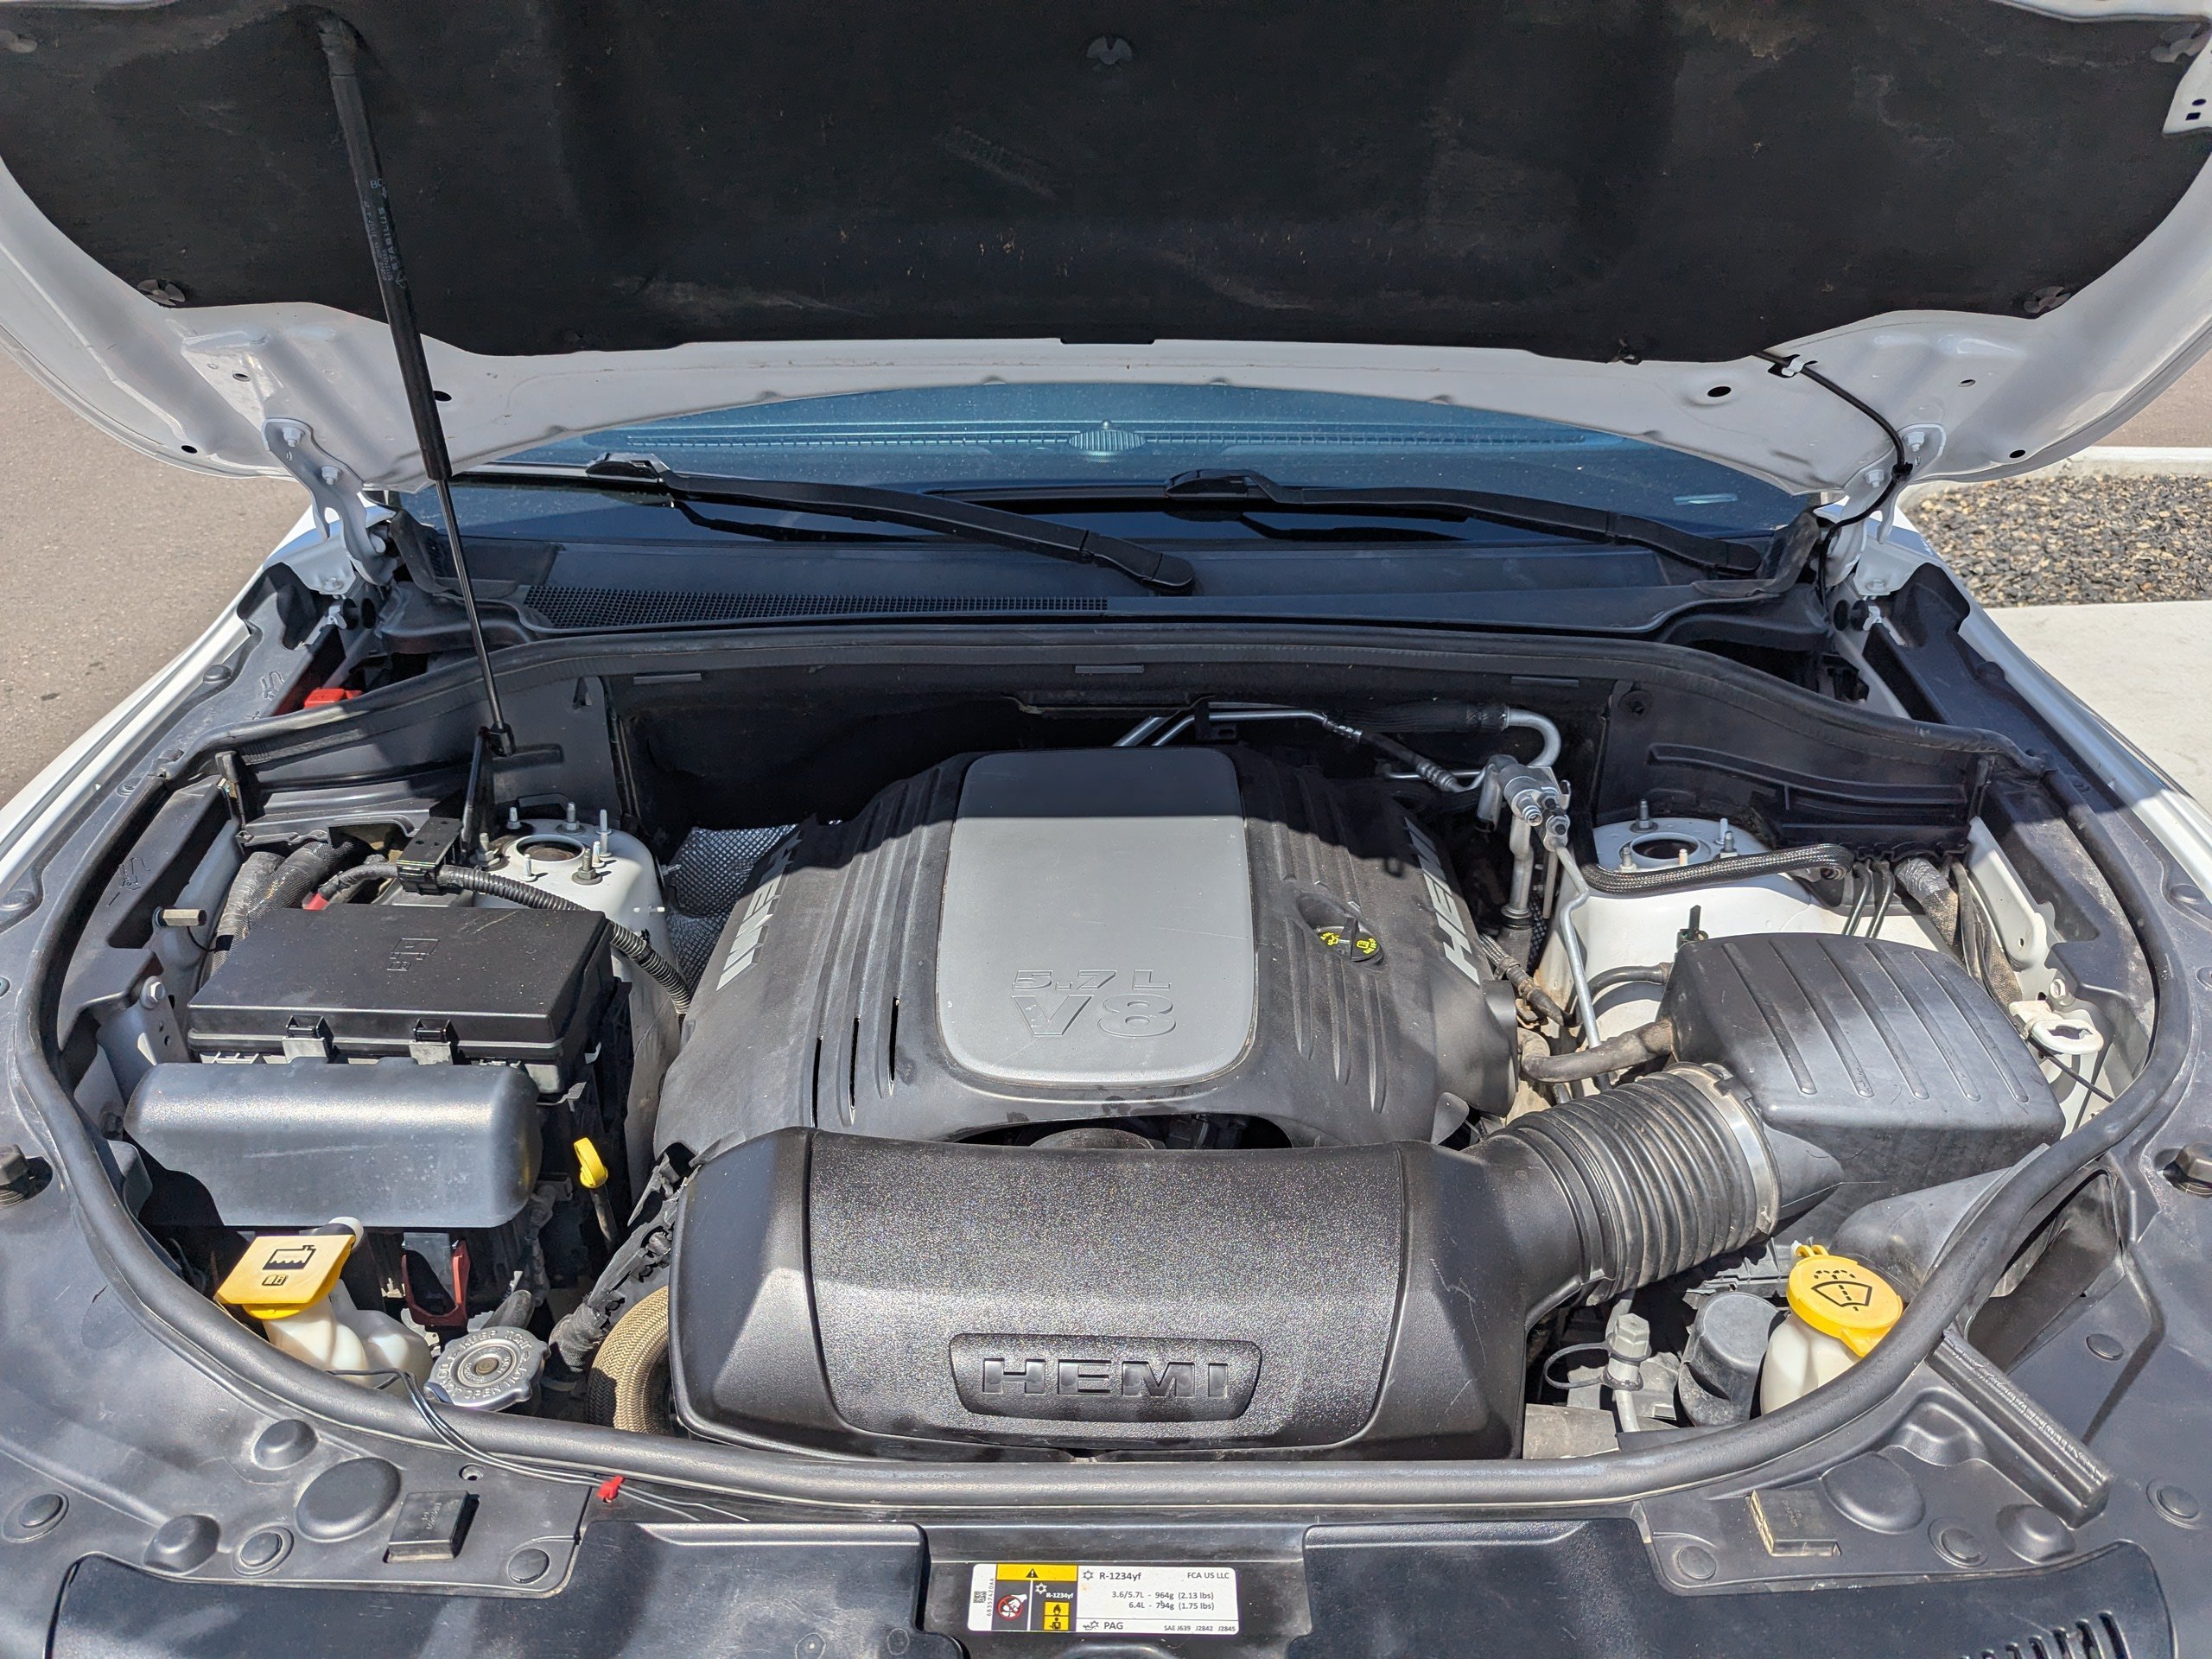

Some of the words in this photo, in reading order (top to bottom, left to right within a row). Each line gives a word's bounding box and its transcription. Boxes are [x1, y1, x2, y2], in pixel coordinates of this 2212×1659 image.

[378, 207, 398, 270] STABILUS
[1404, 816, 1480, 986] HEMI
[1011, 994, 1177, 1037] V8
[459, 1330, 497, 1349] KEEP
[982, 1357, 1229, 1399] HEMI
[464, 1383, 502, 1400] OPEN
[1099, 1572, 1142, 1582] R-1234yf
[1046, 1592, 1074, 1600] R-1234yf
[1111, 1591, 1145, 1599] 3.6/5.7L
[1154, 1592, 1174, 1600] 964g
[1178, 1592, 1198, 1600] (2.13
[1199, 1592, 1214, 1600] lbs)
[1155, 1601, 1175, 1611] 794g
[1178, 1602, 1198, 1611] (1.75
[1200, 1602, 1215, 1611] lbs)
